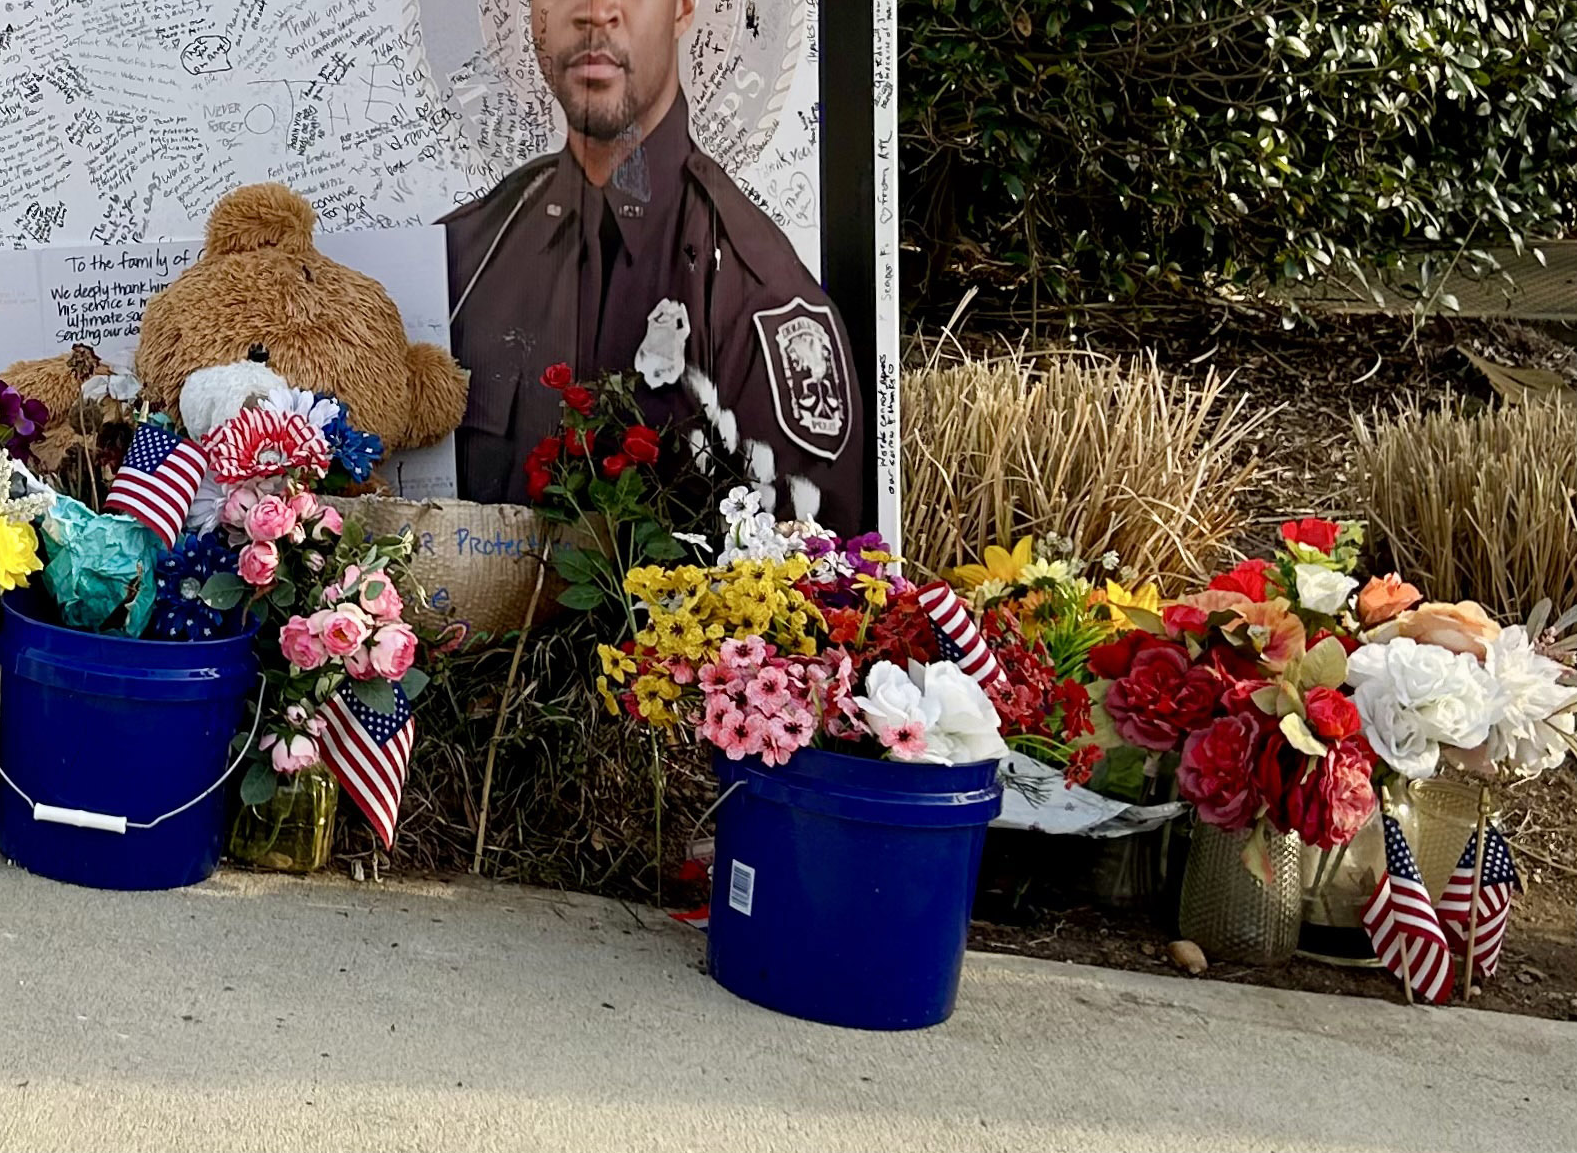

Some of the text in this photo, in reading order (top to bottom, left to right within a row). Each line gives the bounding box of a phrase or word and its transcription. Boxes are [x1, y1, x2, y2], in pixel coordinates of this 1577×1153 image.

[279, 10, 320, 37] Thank
[203, 103, 242, 119] NEVER
[207, 120, 245, 134] FORGET
[65, 248, 191, 277] To the family of
[51, 284, 75, 300] We
[74, 281, 110, 302] deeply
[111, 279, 147, 296] thank
[58, 300, 78, 318] his
[81, 297, 122, 314] service
[67, 312, 123, 329] ultimate
[55, 326, 123, 346] Sending our
[877, 390, 887, 427] cannot
